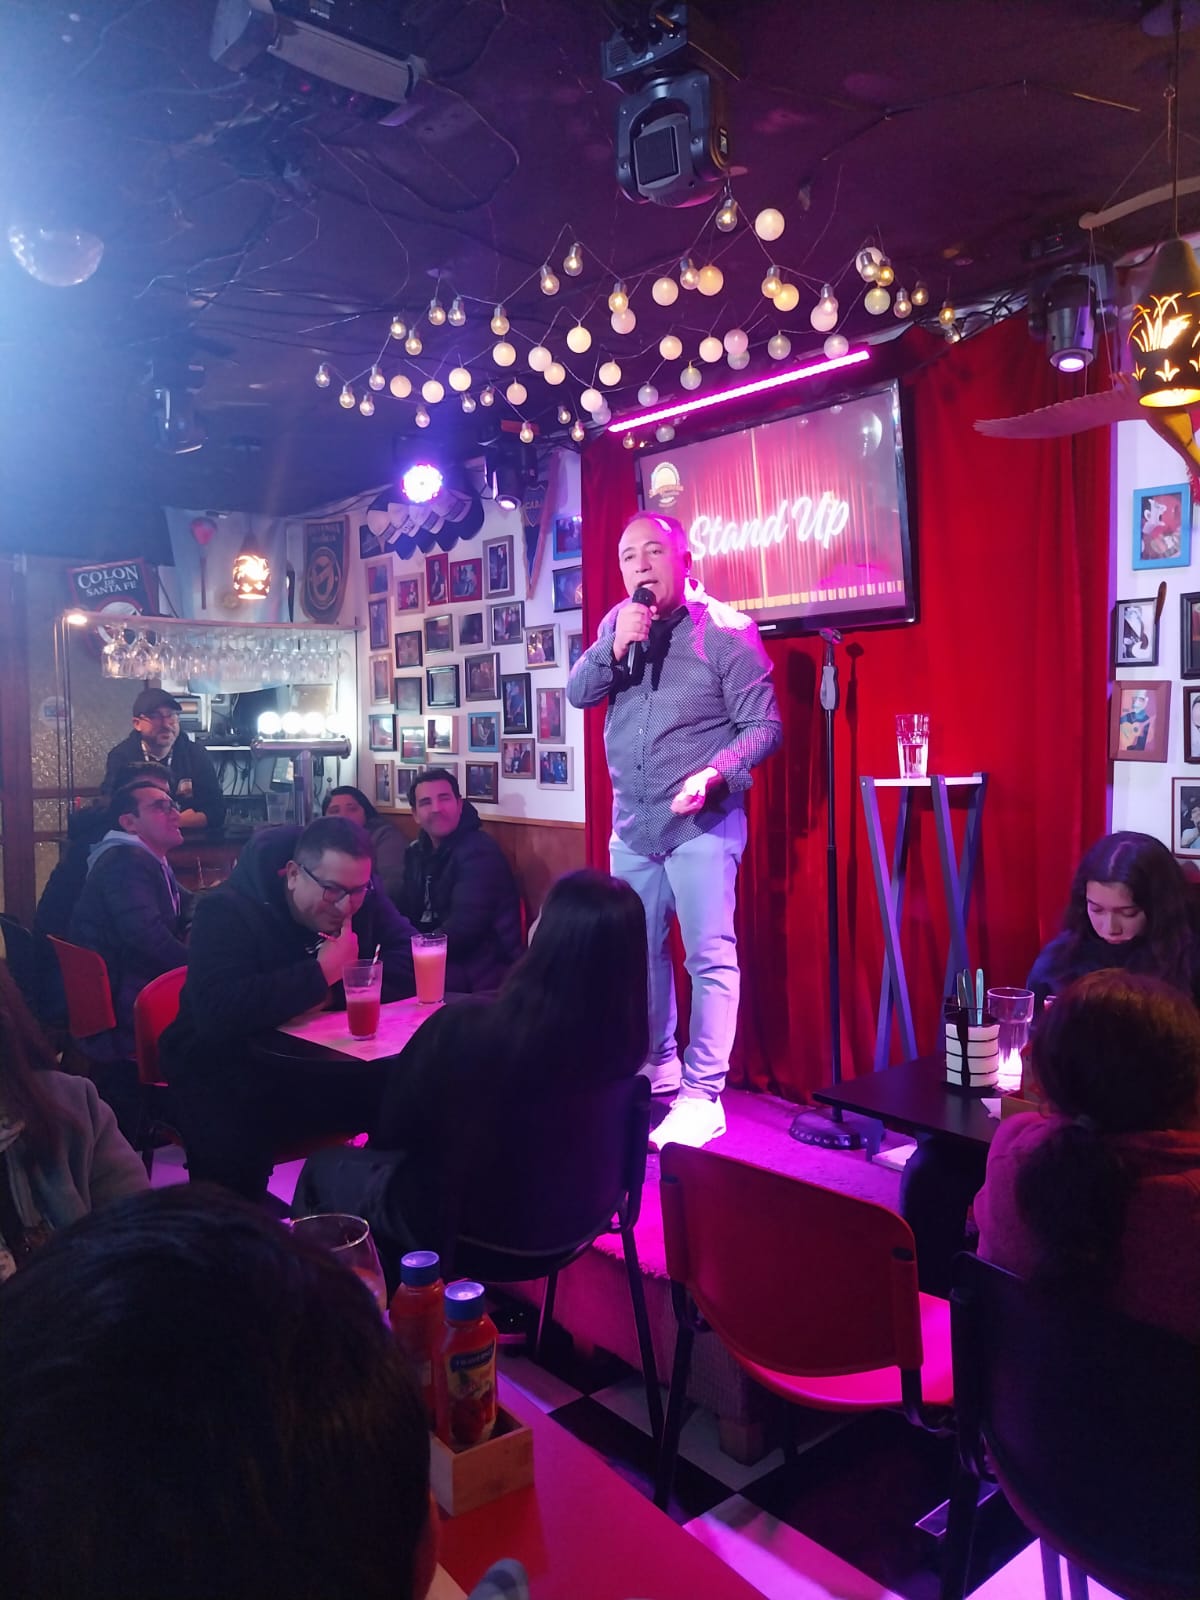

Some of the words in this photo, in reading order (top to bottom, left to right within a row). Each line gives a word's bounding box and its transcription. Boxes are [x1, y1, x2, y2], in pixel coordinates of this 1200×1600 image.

[690, 499, 789, 561] Stand
[791, 490, 849, 549] Up
[78, 565, 138, 589] COLON
[86, 584, 122, 597] SANTA
[123, 580, 137, 591] FE
